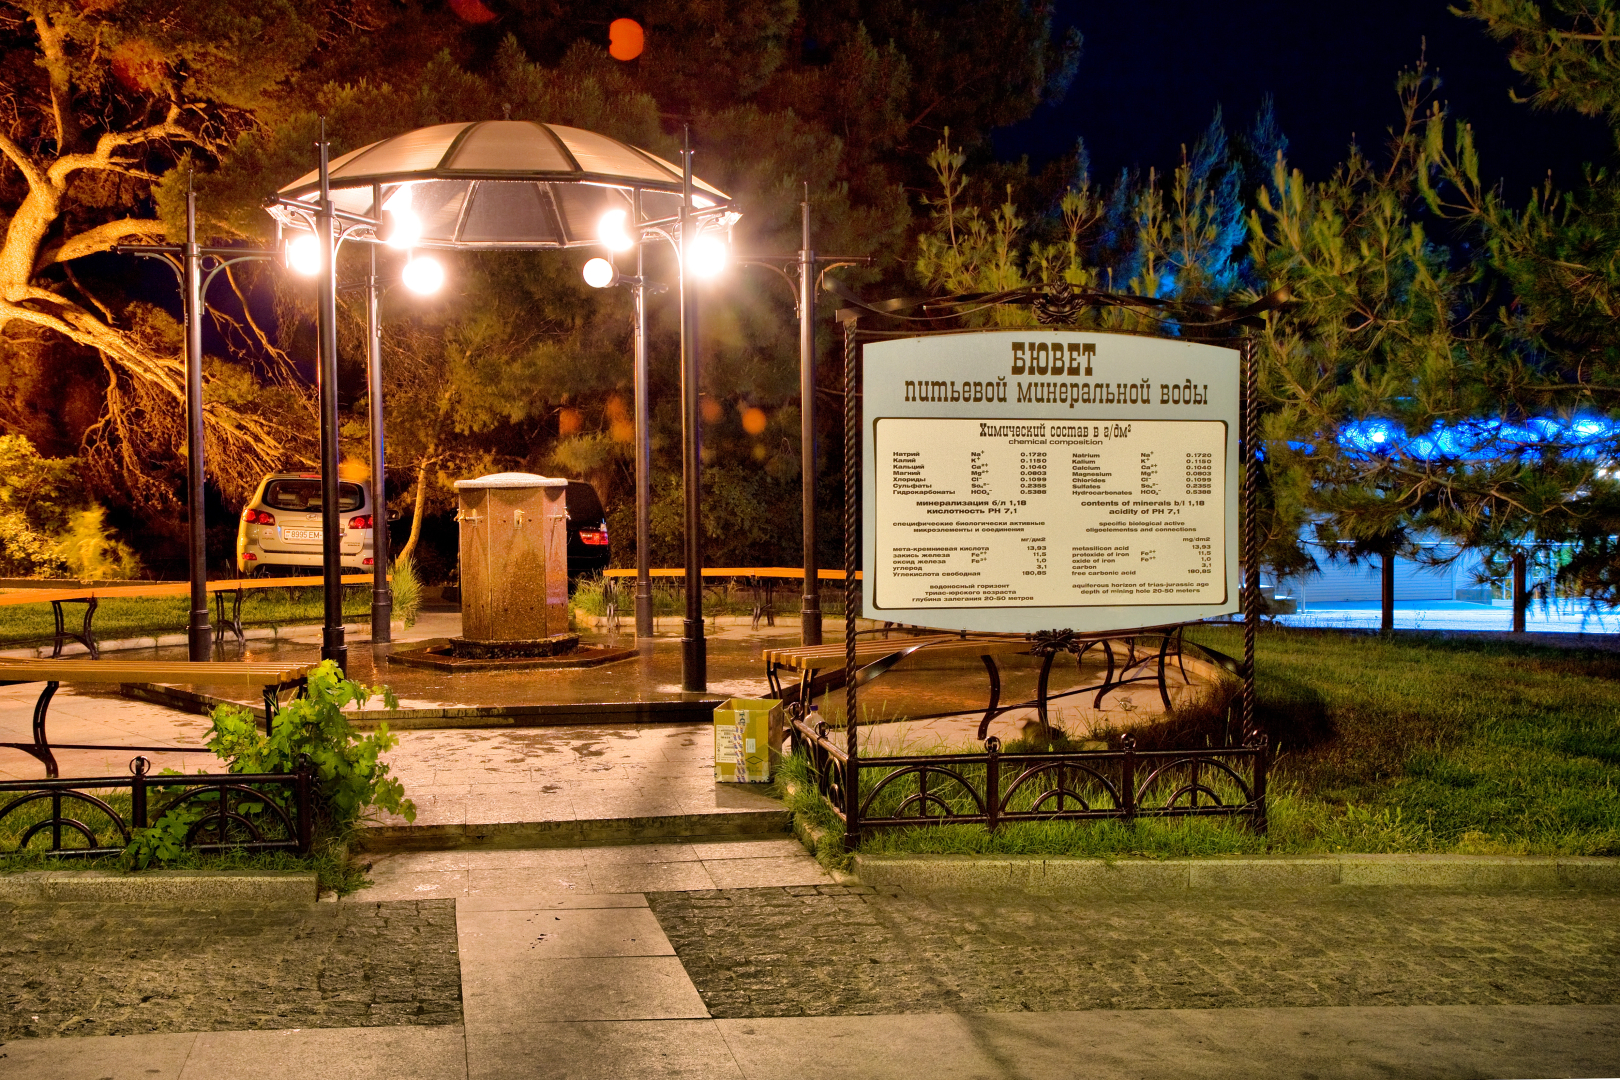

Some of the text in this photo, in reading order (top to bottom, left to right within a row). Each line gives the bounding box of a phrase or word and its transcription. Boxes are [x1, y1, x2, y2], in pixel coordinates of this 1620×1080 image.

[1011, 342, 1096, 376] БЮВЕТ
[905, 376, 1207, 408] питьевой минеральной воды
[980, 423, 1046, 437] Химический
[1050, 426, 1089, 437] состав
[1093, 427, 1099, 437] в
